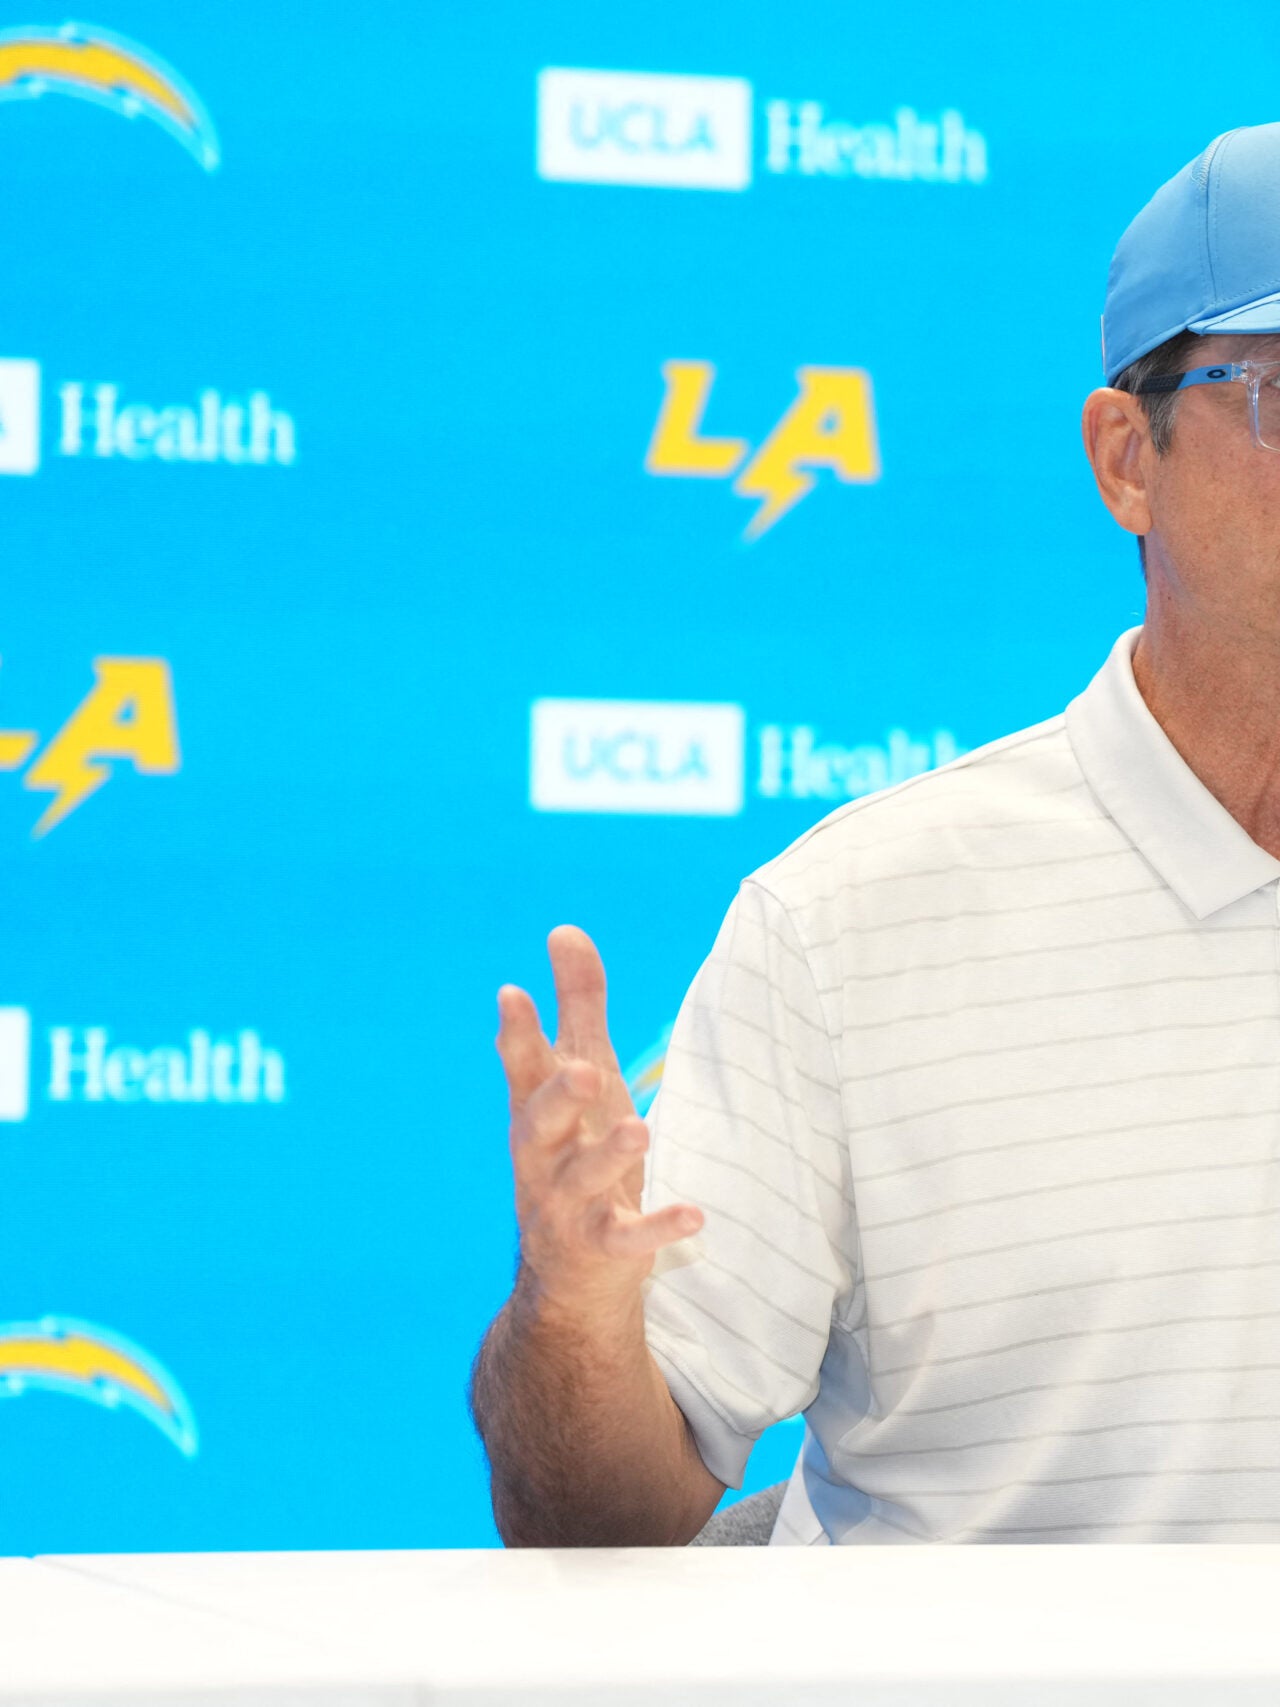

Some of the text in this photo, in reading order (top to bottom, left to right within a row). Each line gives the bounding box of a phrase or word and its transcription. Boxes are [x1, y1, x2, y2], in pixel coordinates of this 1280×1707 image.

[569, 99, 985, 183] UCLA Health
[58, 381, 296, 466] Health
[645, 359, 881, 542] LA
[0, 655, 181, 838] A
[563, 728, 709, 783] UCLA
[48, 1025, 286, 1103] Health
